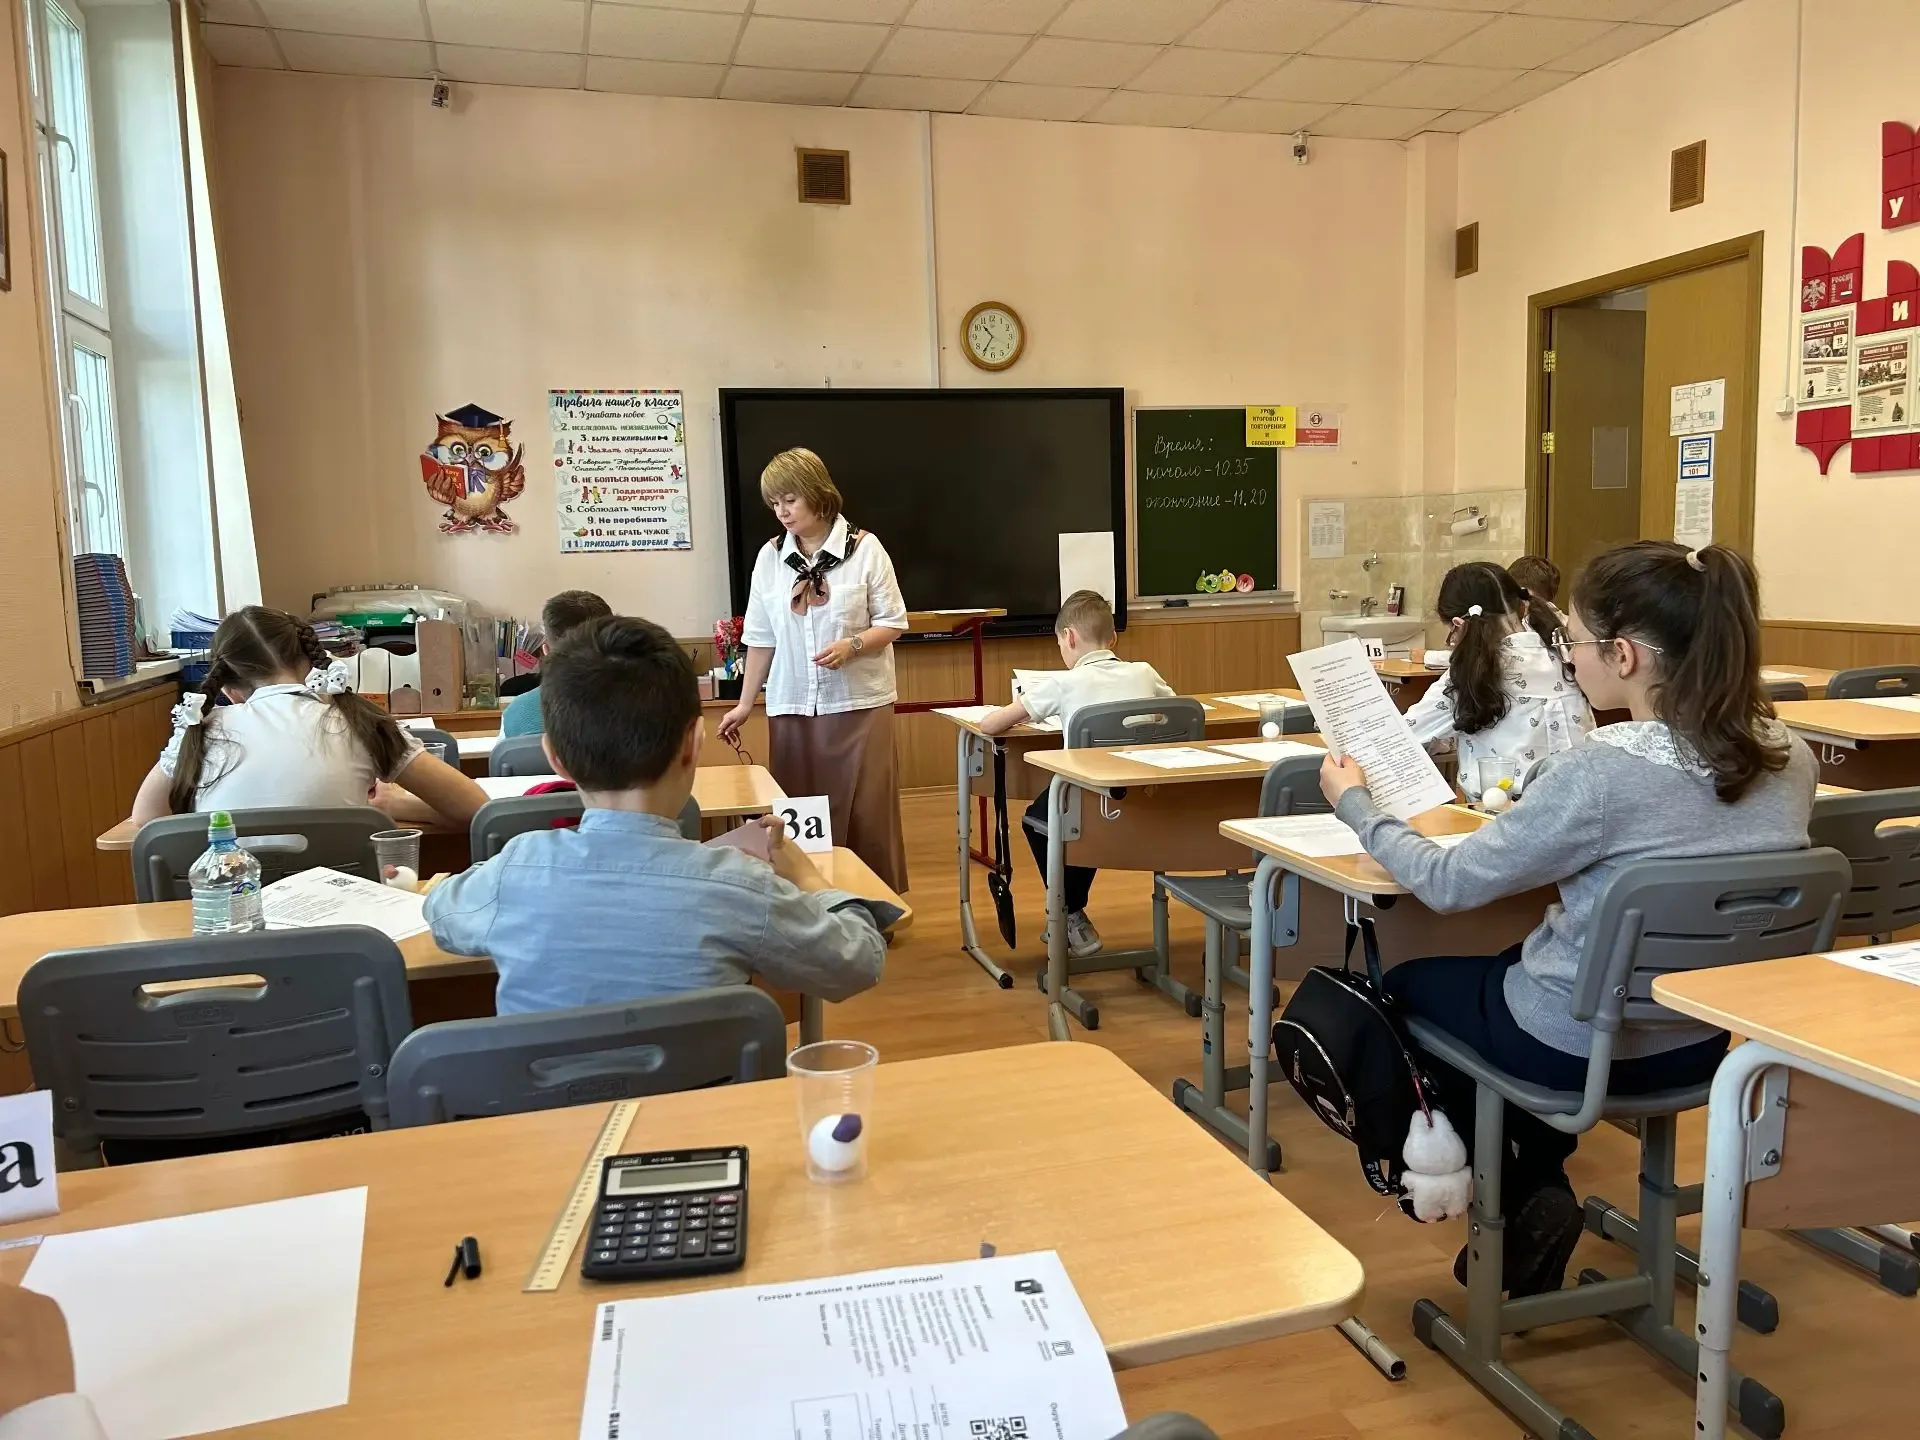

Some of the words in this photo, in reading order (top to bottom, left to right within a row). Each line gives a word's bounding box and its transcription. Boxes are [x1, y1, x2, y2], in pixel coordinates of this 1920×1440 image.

[555, 395, 602, 411] Правила
[605, 396, 641, 408] нашего
[644, 396, 680, 407] класса
[579, 411, 621, 420] Узнавать
[623, 411, 645, 419] новое
[588, 445, 622, 454] Уважать
[1688, 467, 1699, 475] 101
[612, 488, 680, 496] Поддерживать
[613, 516, 668, 524] перебивать
[584, 540, 630, 548] ПРИХОДИТЬ
[631, 539, 669, 547] ВОВРЕМЯ
